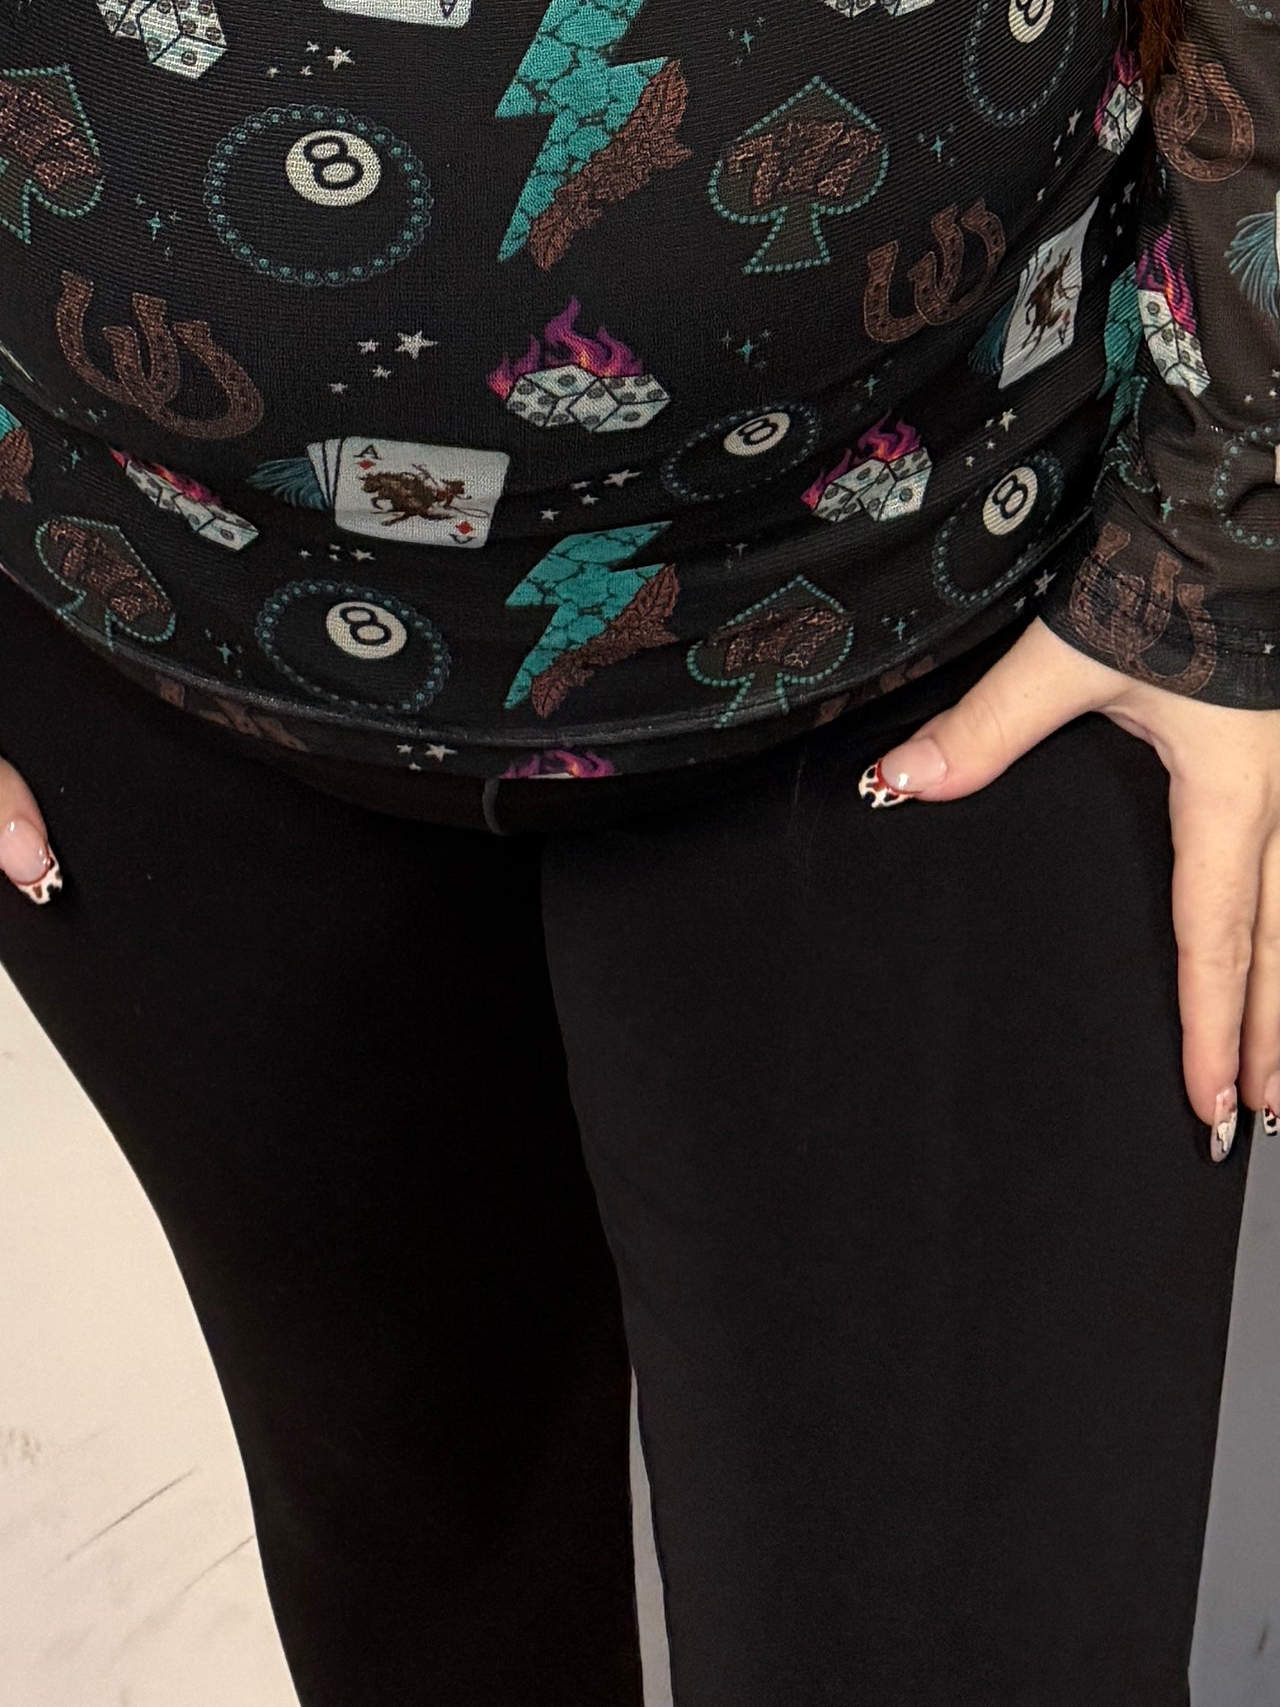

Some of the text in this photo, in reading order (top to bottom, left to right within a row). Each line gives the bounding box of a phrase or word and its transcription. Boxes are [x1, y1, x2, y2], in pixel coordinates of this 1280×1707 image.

[304, 136, 368, 190] 8
[353, 444, 382, 460] A
[740, 418, 779, 447] 8
[993, 476, 1029, 520] 8
[339, 607, 390, 648] 8
